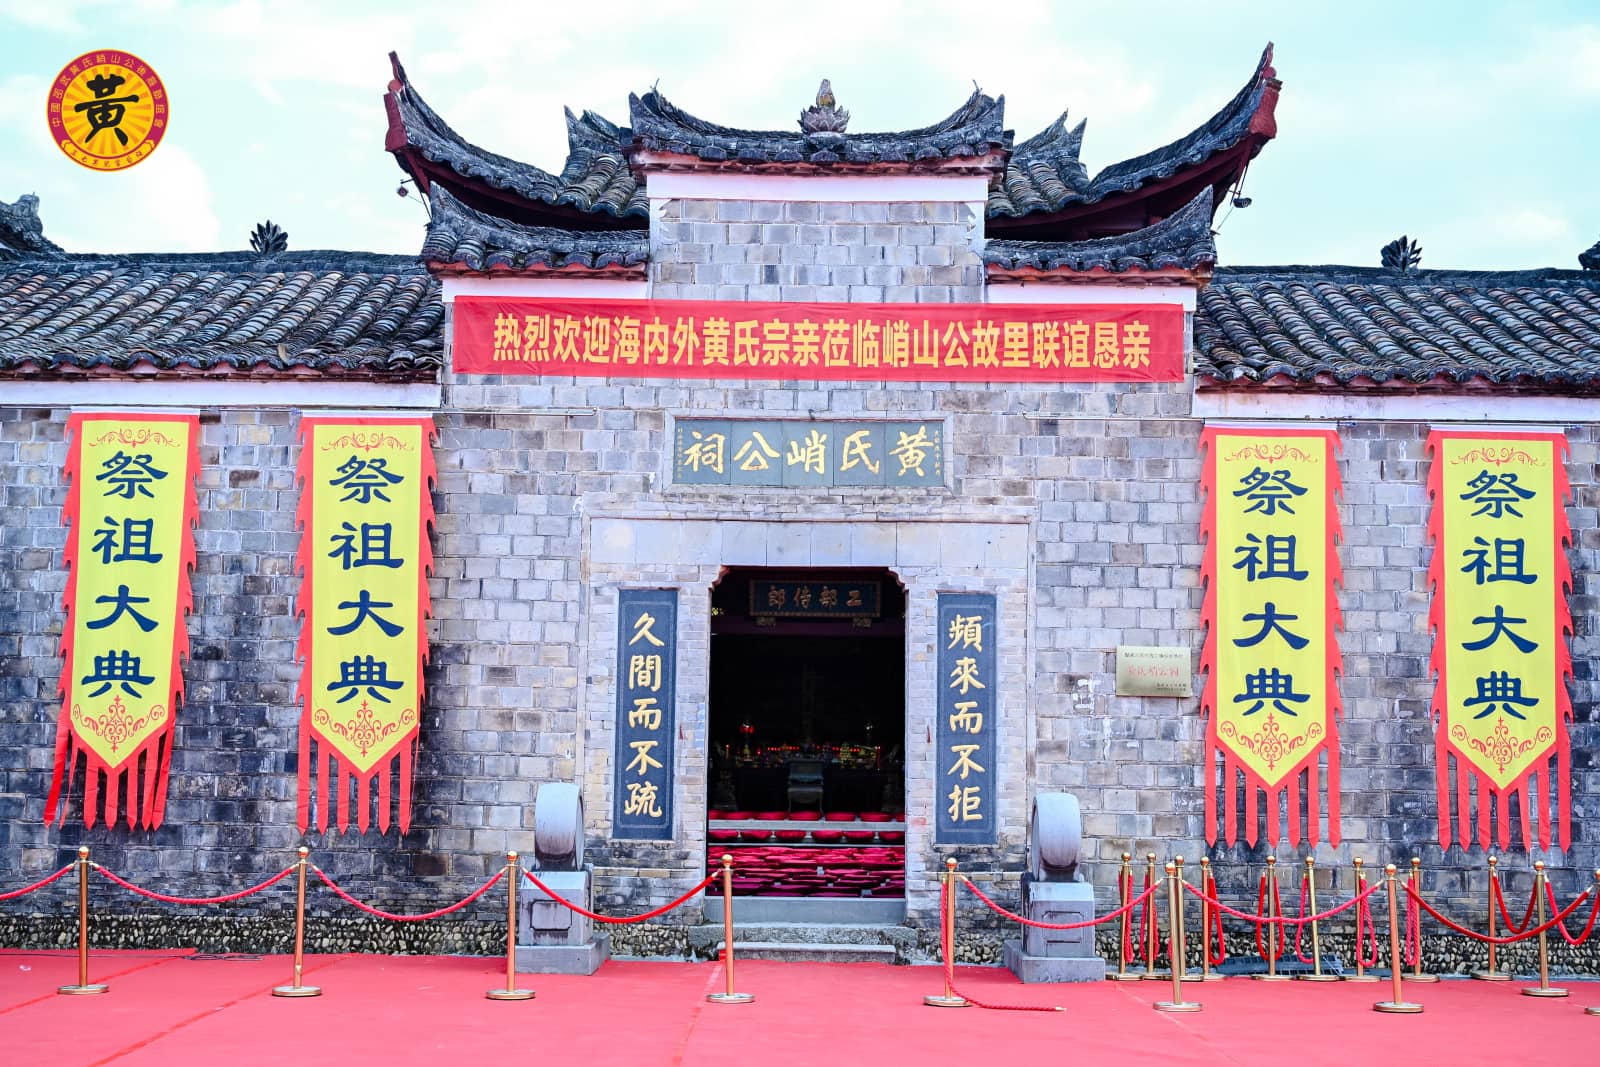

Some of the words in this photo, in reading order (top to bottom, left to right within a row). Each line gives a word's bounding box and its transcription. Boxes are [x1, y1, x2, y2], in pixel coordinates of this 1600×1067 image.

[492, 312, 1151, 369] 热烈欢迎海内外黄氏宗亲莅临峭山公故里联谊恳亲
[81, 450, 168, 699] 祭祖大典
[326, 455, 404, 704] 祭祖大典
[1232, 466, 1311, 716] 祭祖大典
[1459, 469, 1540, 720] 祭祖大典
[947, 614, 986, 823] 頻來而不拒
